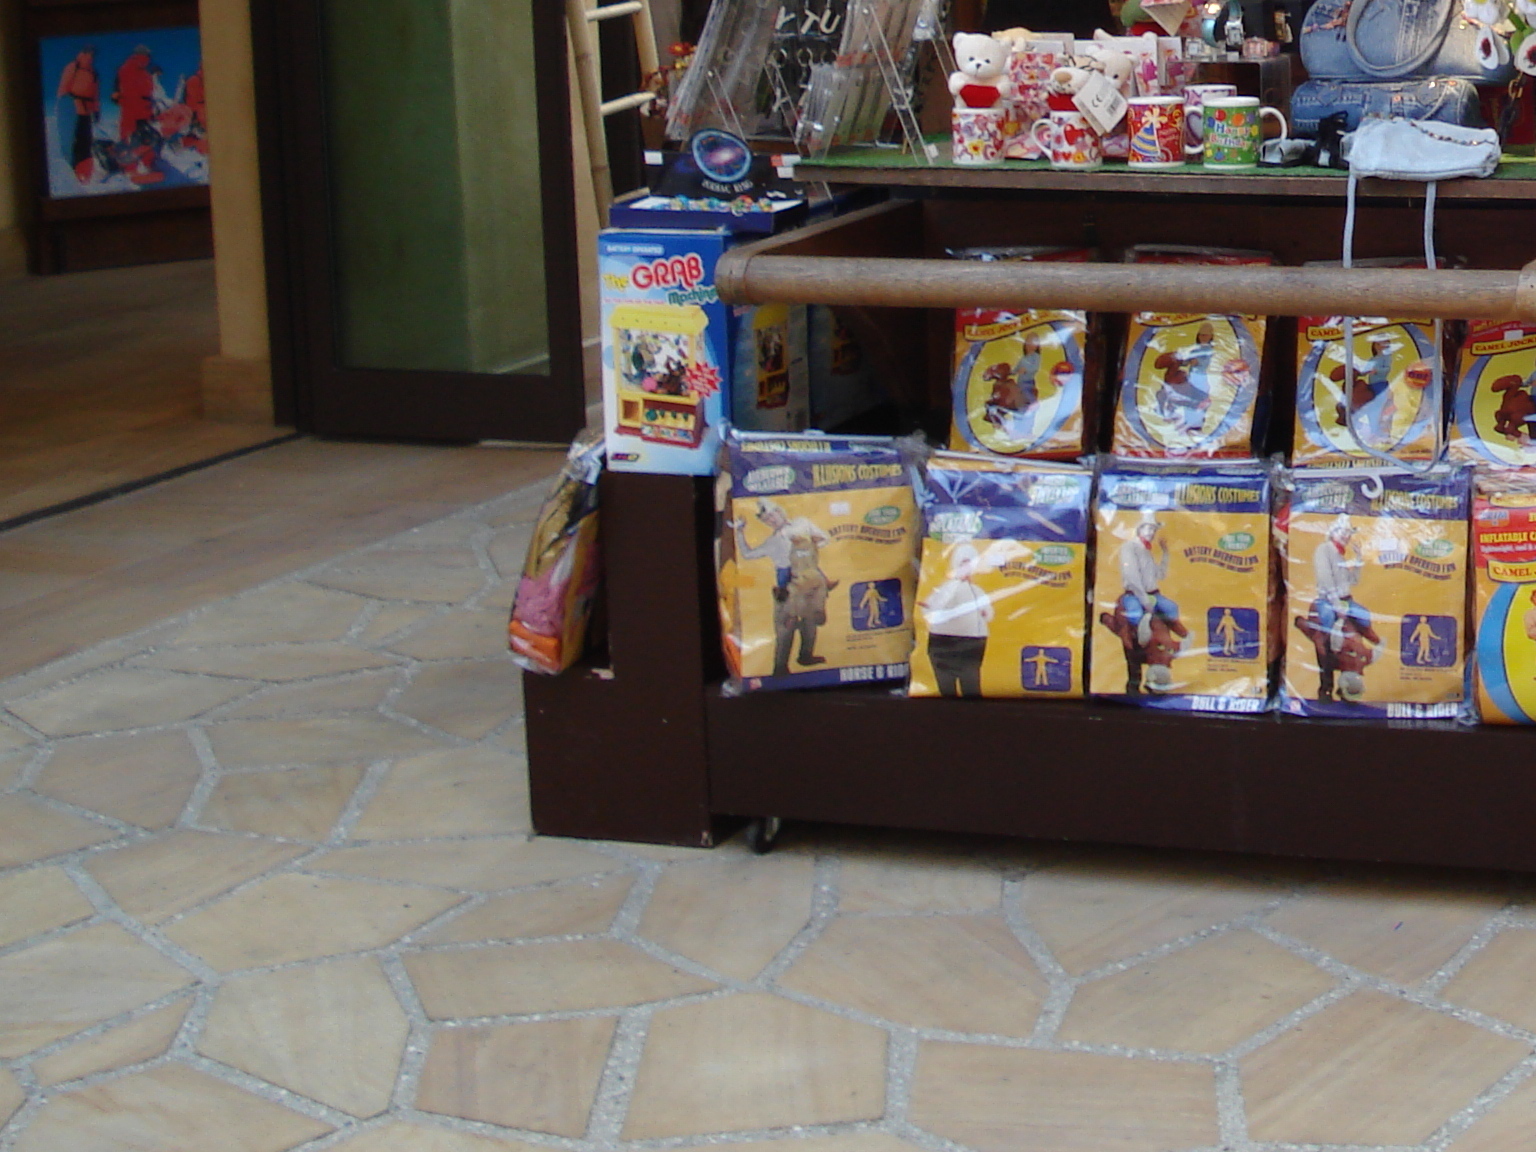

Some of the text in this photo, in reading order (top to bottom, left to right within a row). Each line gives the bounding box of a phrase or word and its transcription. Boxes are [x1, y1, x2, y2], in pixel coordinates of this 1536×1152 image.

[801, 9, 820, 35] T
[819, 9, 841, 34] U
[1215, 122, 1251, 137] Happy
[1210, 133, 1250, 150] Birthday
[603, 253, 704, 292] The GRAB
[668, 285, 719, 306] Machine
[1310, 327, 1341, 337] CAMEL
[1475, 341, 1506, 352] CAMEL
[812, 464, 903, 488] ILLUSIONS COSTUMES
[1175, 482, 1217, 506] ILLUSIONS
[1218, 487, 1262, 504] COSTUMES
[1480, 530, 1529, 543] INFLATABLE
[1184, 546, 1259, 566] BATTERY OPERATED FAN
[1409, 555, 1442, 574] OPERATED
[1441, 563, 1457, 574] FAN
[1493, 564, 1533, 577] CAMEL
[839, 666, 874, 682] HORSE
[1191, 696, 1216, 710] BULL
[1228, 698, 1260, 712] RIDER
[1386, 703, 1412, 718] BULL
[1426, 702, 1459, 718] RIDER
